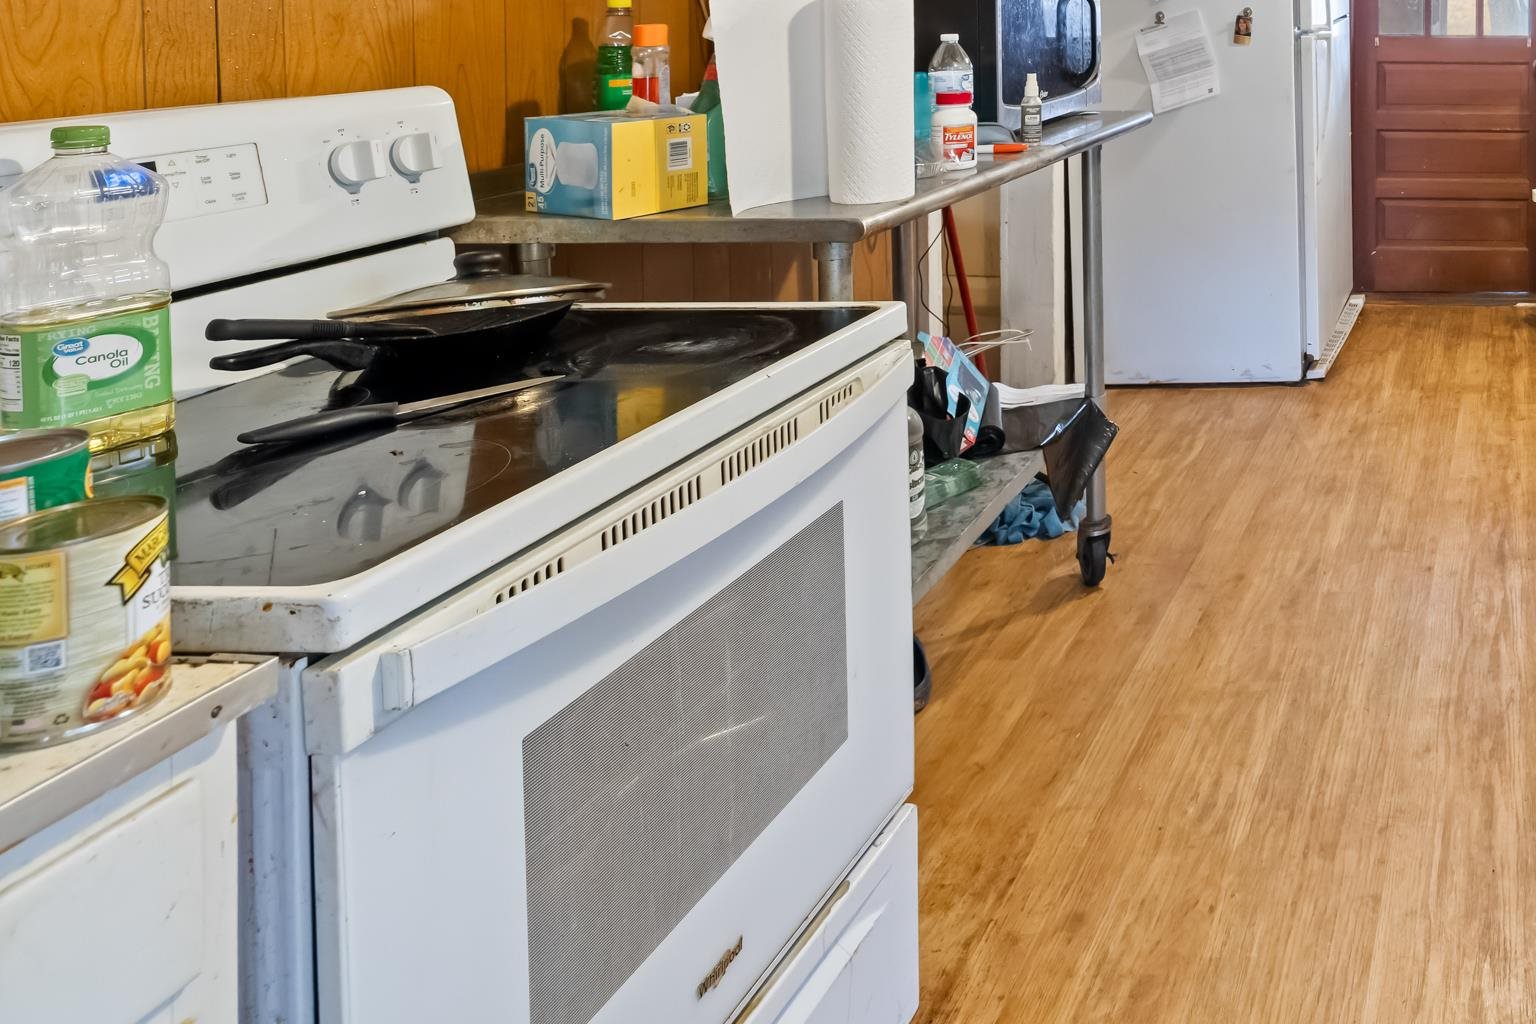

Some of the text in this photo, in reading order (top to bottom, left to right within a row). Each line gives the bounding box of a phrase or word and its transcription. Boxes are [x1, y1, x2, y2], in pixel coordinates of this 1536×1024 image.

[944, 131, 973, 141] TYLENOL
[56, 340, 84, 351] Great
[75, 348, 129, 366] Canola
[110, 356, 129, 369] Oil
[696, 934, 743, 1000] Whirlpool
